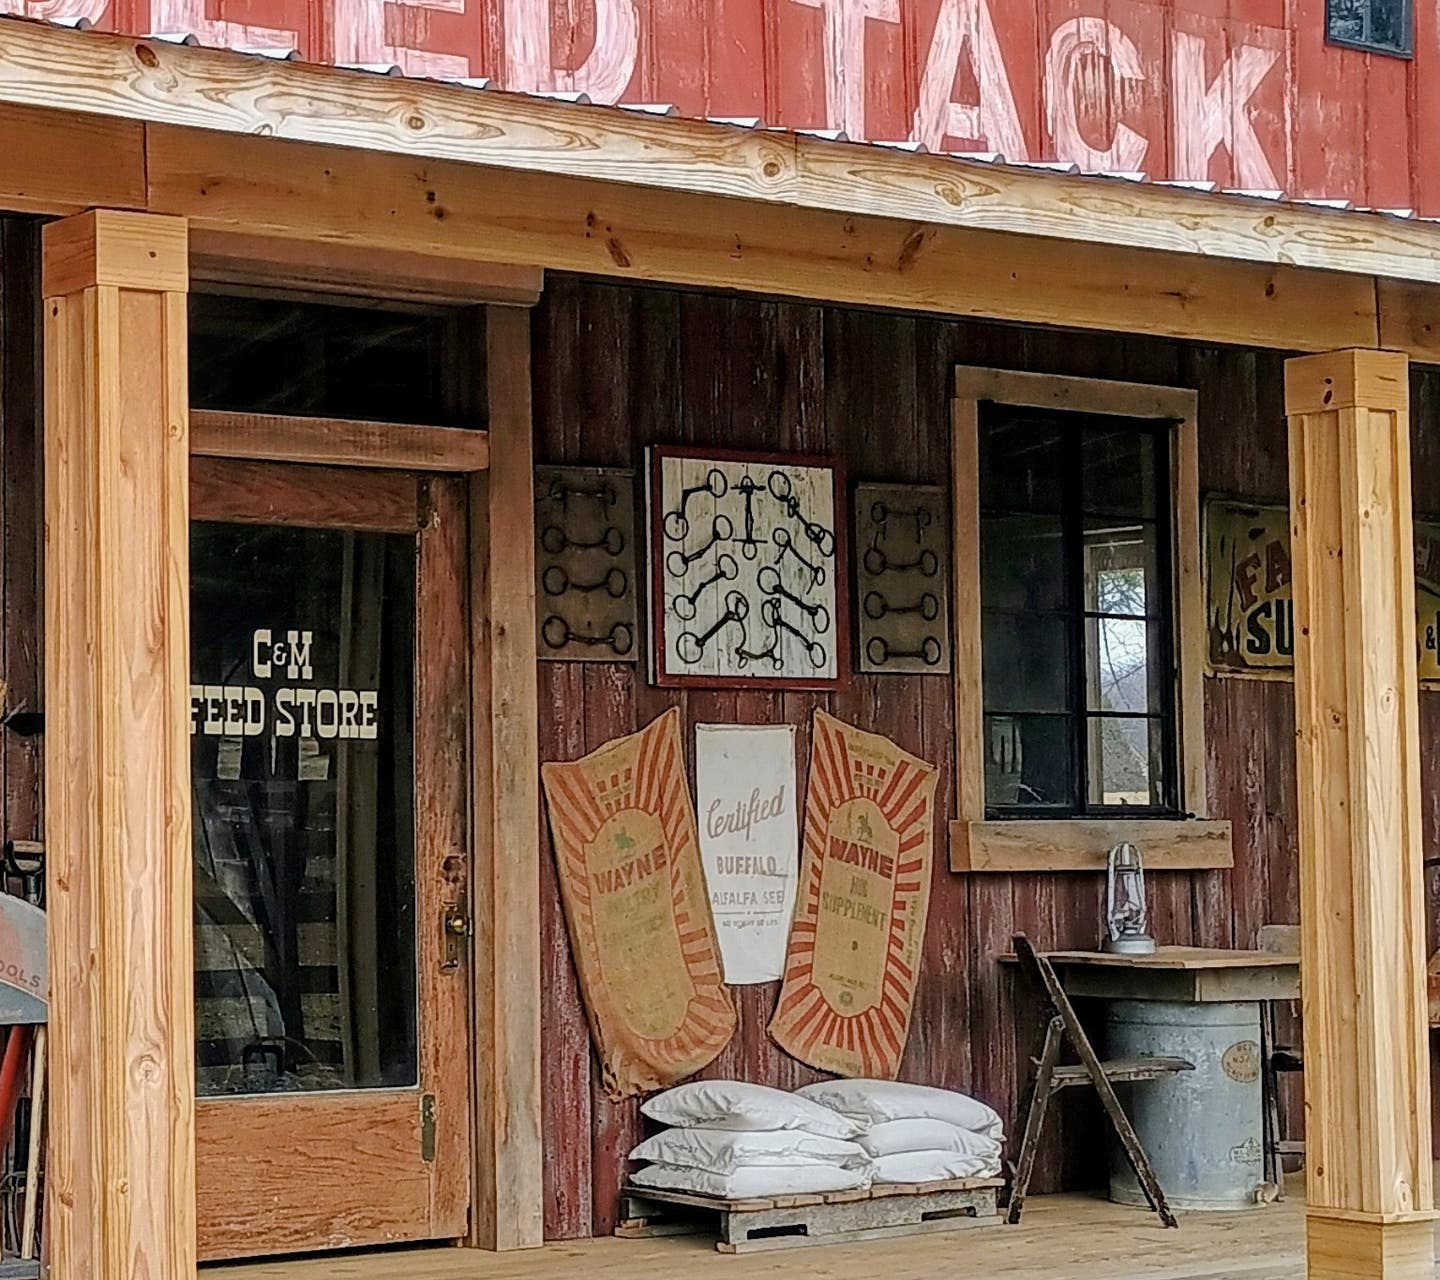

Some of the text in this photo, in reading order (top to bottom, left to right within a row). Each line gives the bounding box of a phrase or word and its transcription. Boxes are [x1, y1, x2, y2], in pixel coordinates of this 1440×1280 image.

[253, 629, 313, 680] C&M
[190, 684, 378, 739] FEED STORE
[706, 784, 786, 841] Certified
[593, 843, 667, 894] WAYNE
[716, 855, 777, 875] BUFFALO
[829, 836, 895, 880] WAYNE
[712, 890, 758, 906] ALFALFA
